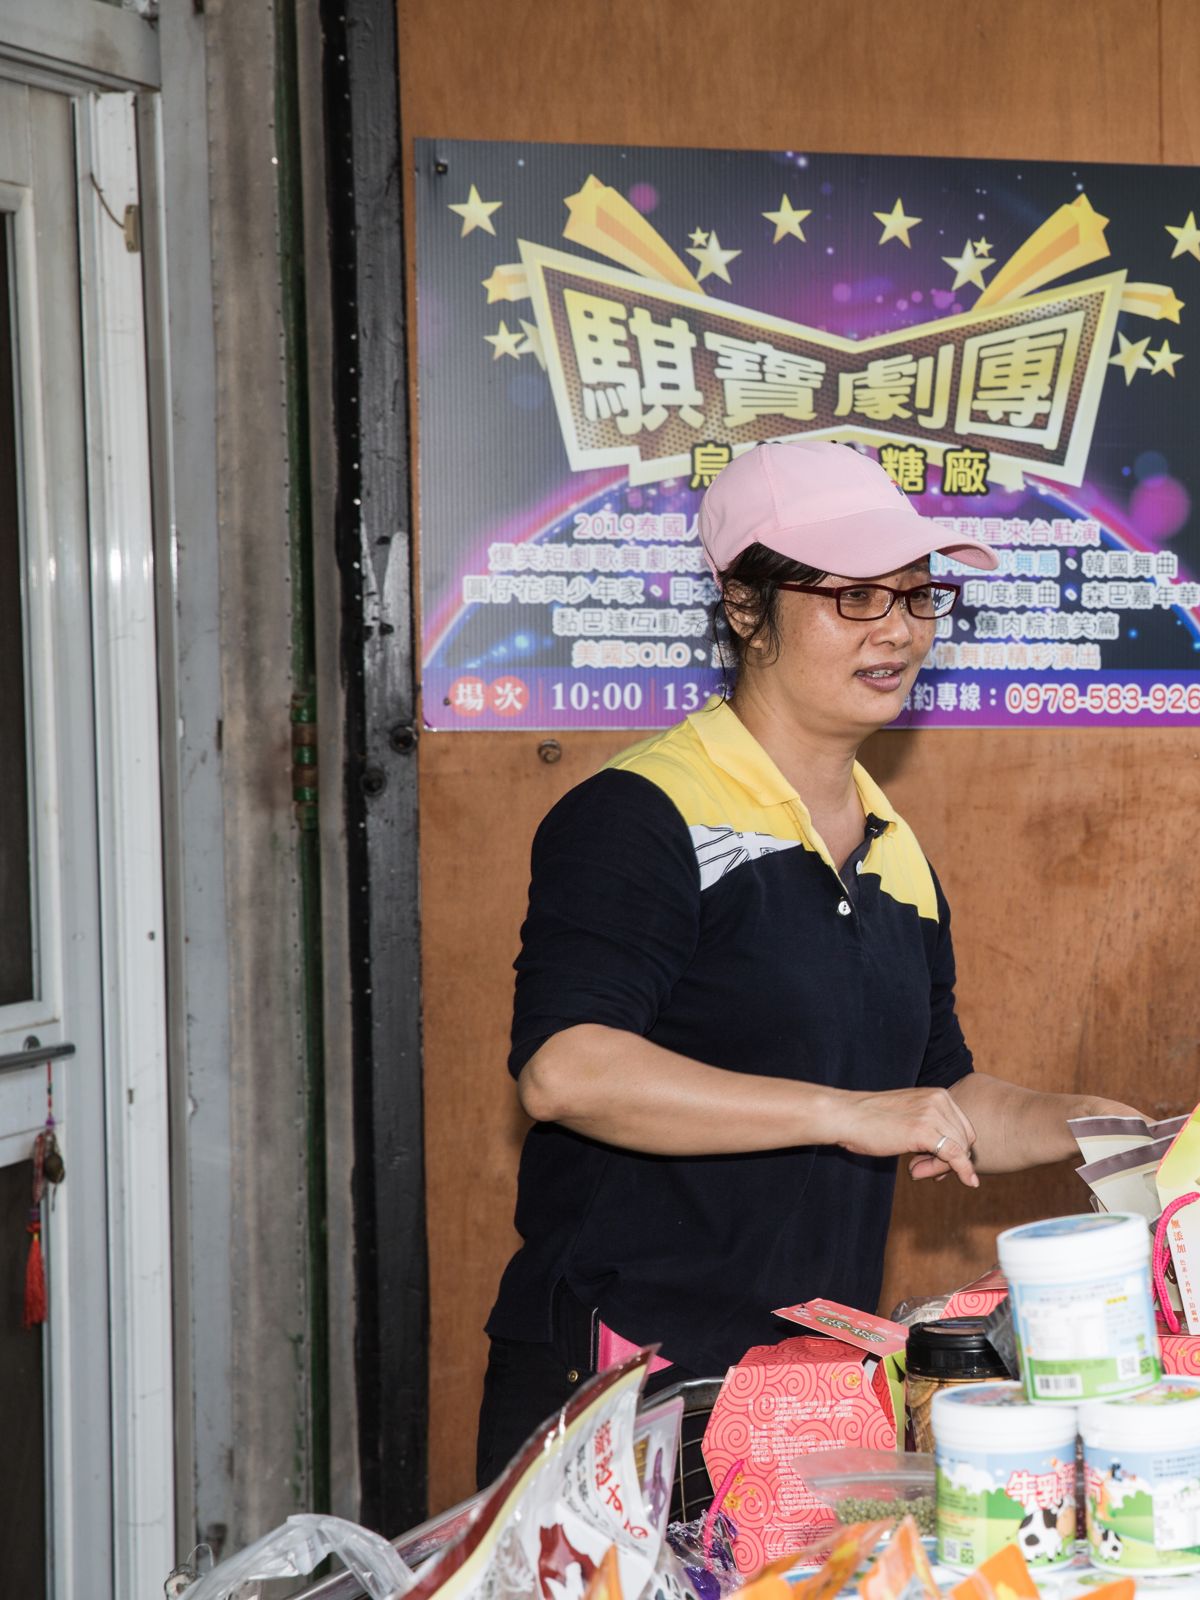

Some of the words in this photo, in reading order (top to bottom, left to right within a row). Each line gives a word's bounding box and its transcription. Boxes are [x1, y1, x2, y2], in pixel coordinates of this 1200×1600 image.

[880, 446, 990, 496] 糖廠
[454, 682, 524, 711] 場次
[551, 683, 642, 711] 10:00
